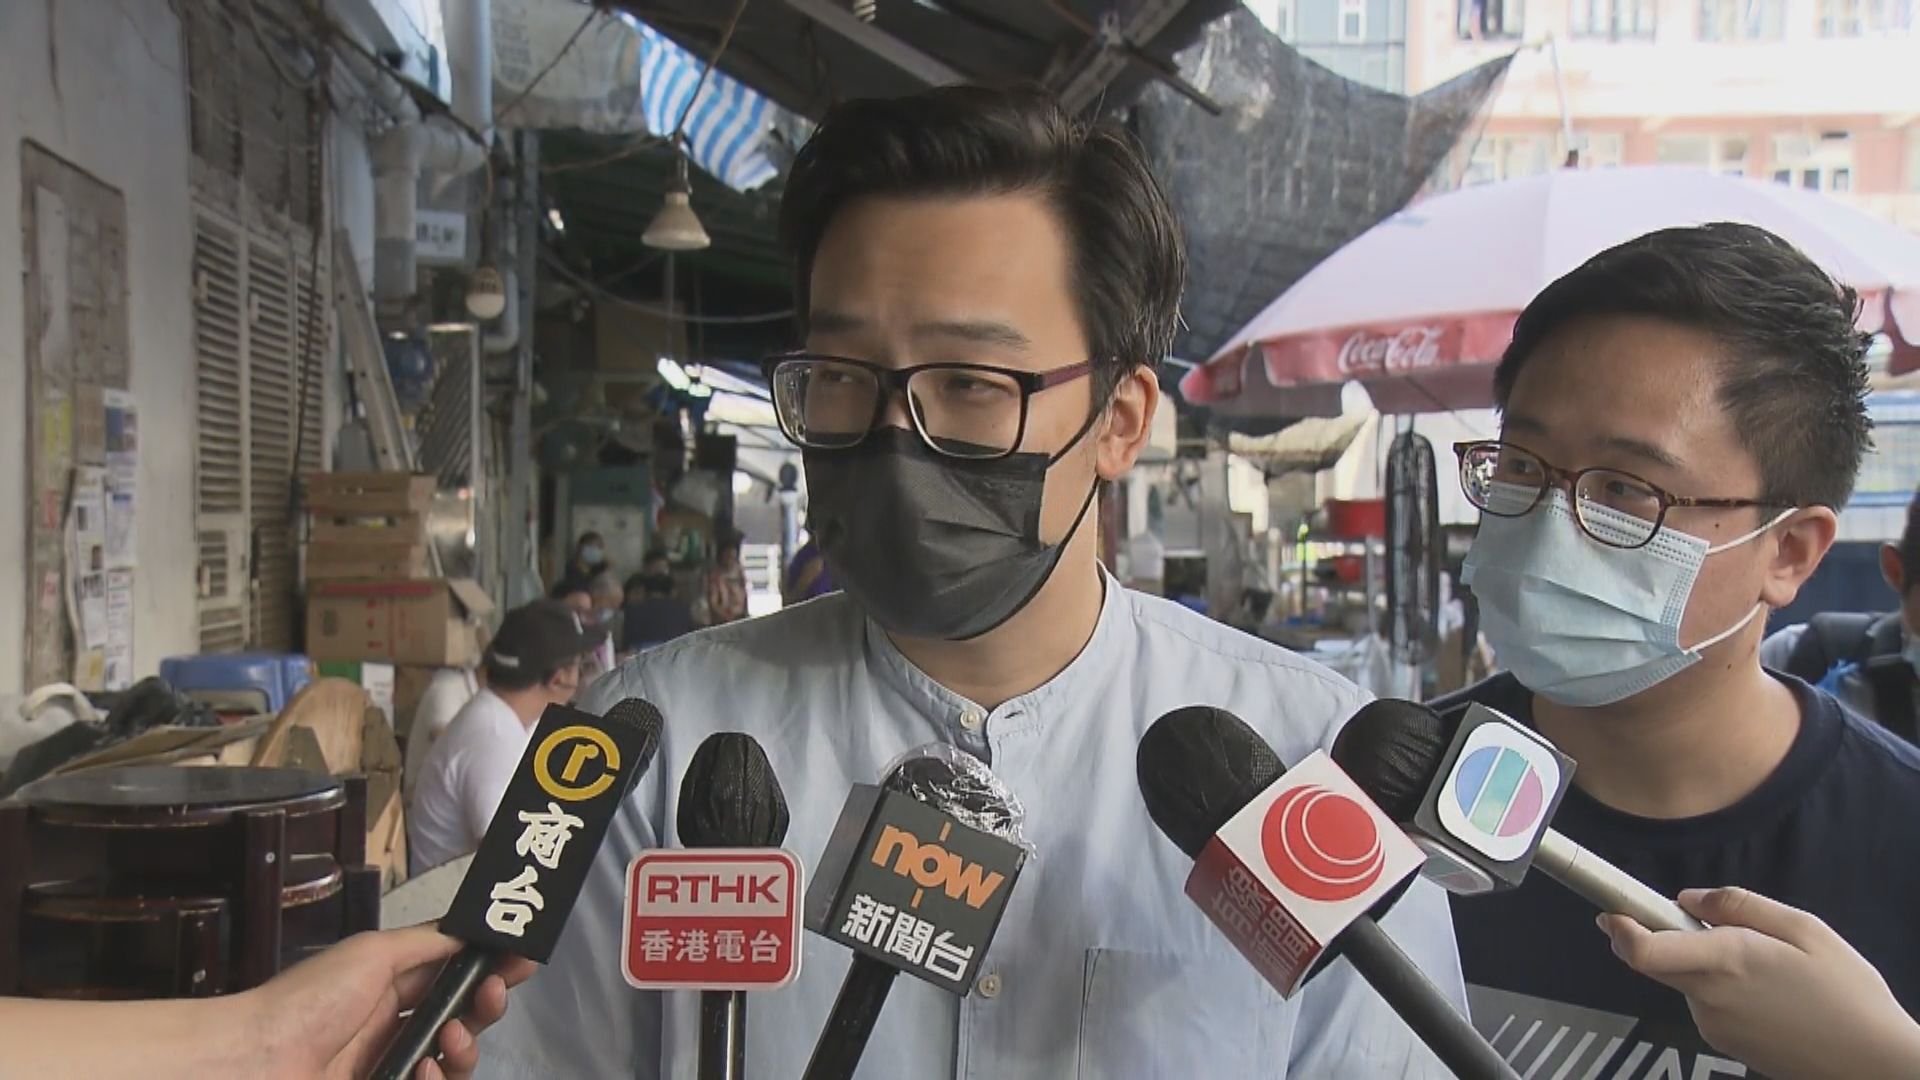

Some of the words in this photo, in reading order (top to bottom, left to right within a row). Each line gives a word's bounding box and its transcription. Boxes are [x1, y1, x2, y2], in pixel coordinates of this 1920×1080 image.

[485, 802, 584, 937] 商台
[647, 875, 782, 904] RTHK
[871, 823, 1005, 910] now
[640, 929, 782, 964] 香港電台
[841, 893, 974, 982] 新聞台
